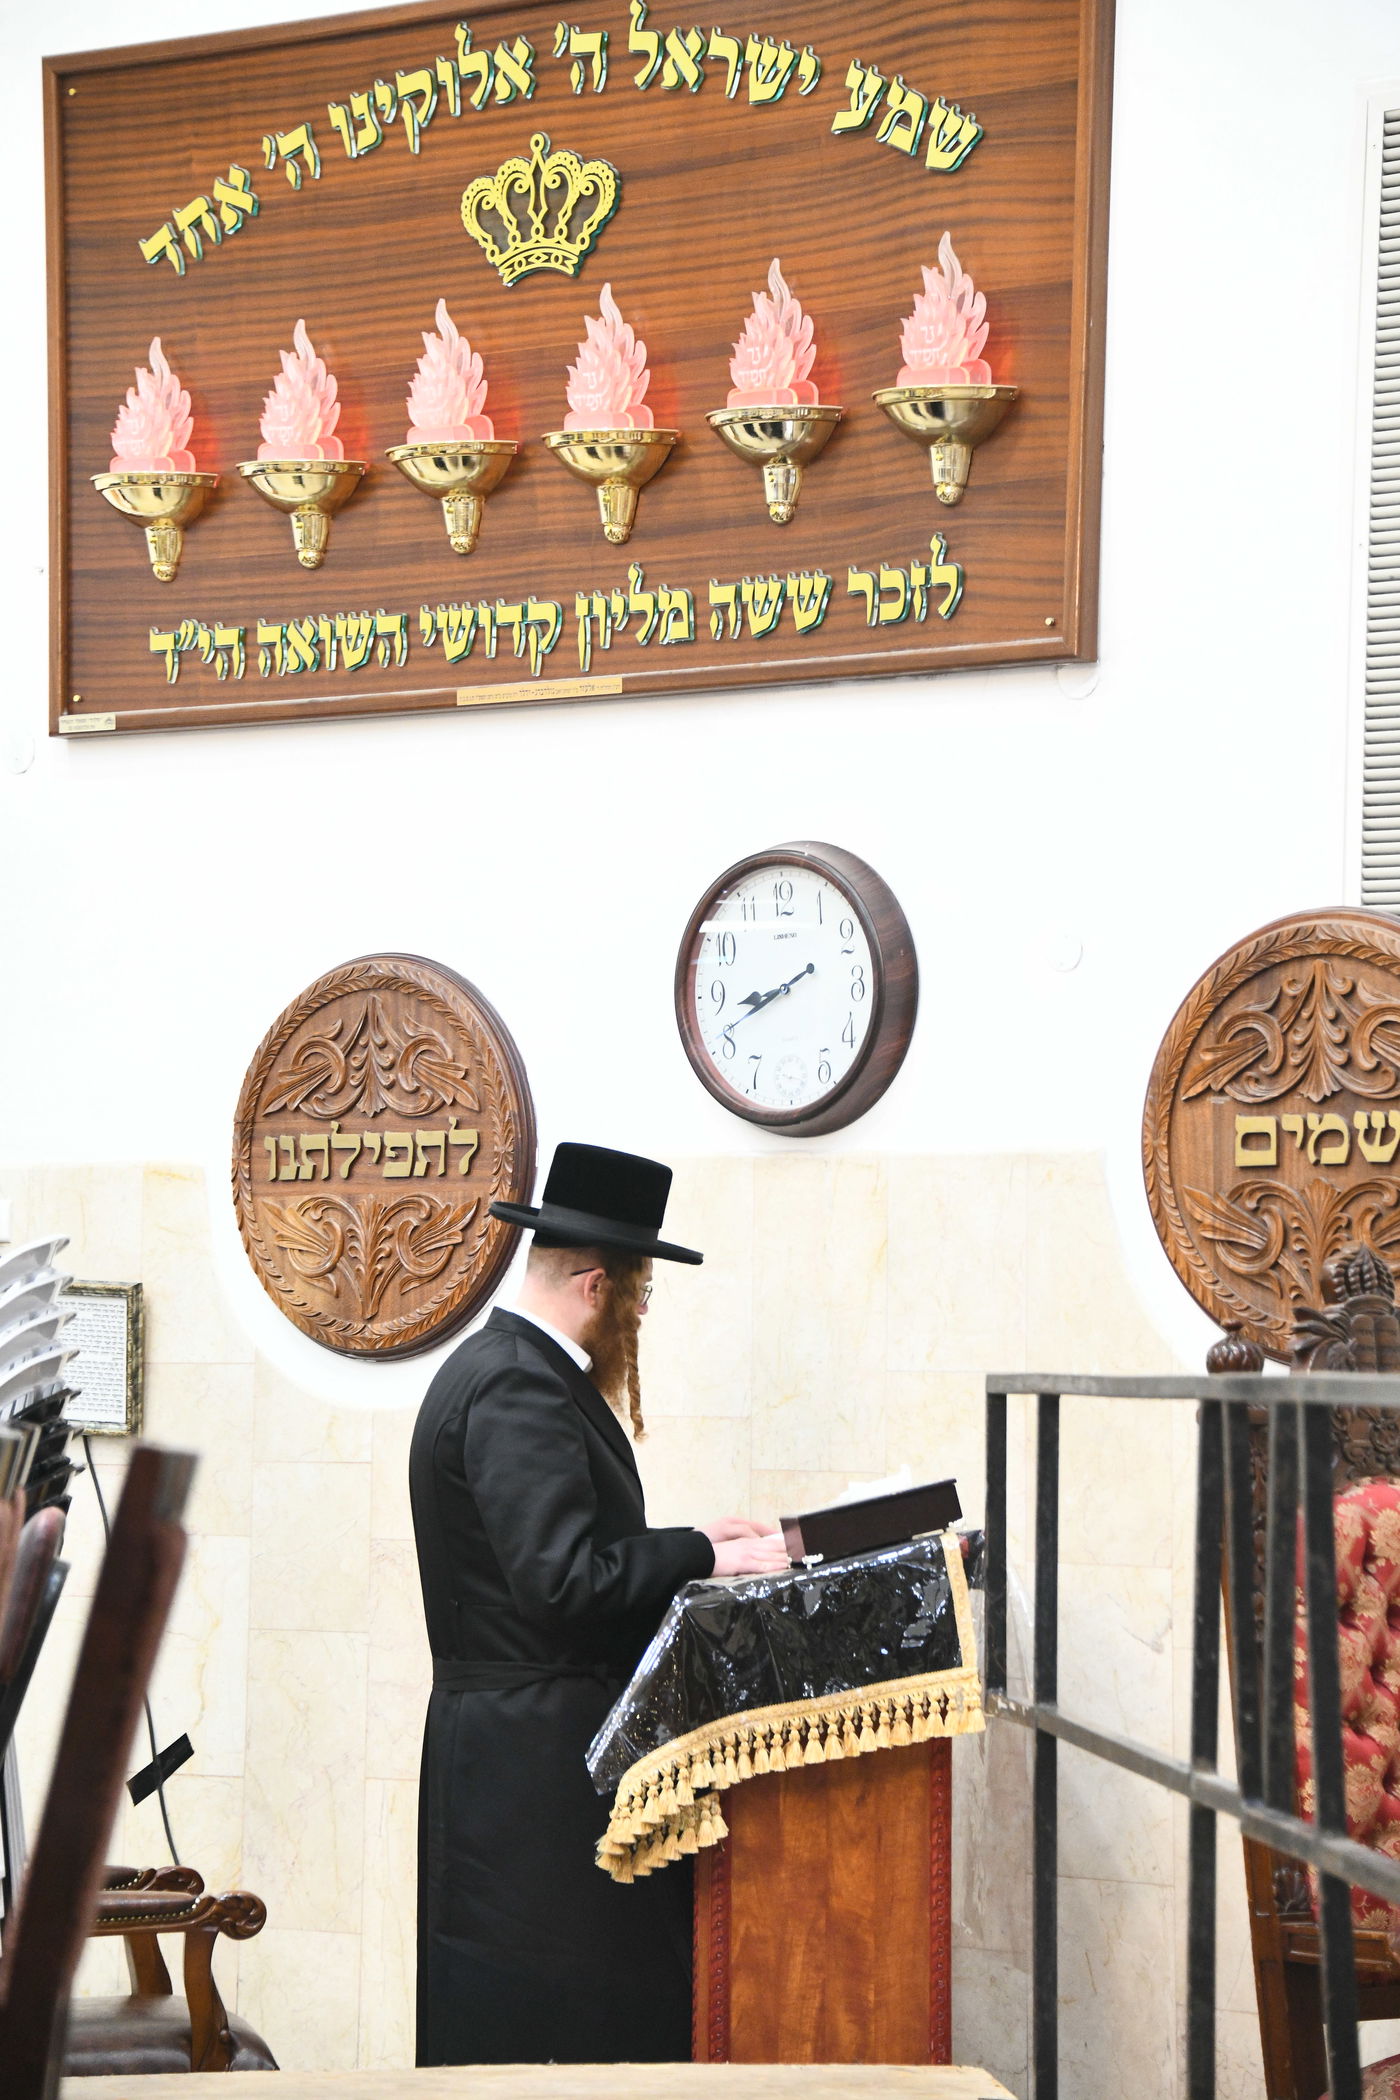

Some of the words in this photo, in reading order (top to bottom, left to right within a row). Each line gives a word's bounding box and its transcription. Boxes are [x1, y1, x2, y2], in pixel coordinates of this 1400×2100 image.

[629, 0, 822, 105] ישראל
[328, 21, 536, 157] אלוקינו
[831, 57, 983, 172] שמע
[138, 163, 259, 275] אחד
[847, 532, 963, 628] לזכר
[575, 561, 695, 672] מליון
[708, 569, 832, 640] ששה
[256, 608, 408, 678] השואה
[419, 596, 563, 677] קדושי
[742, 895, 756, 932] 11
[772, 880, 795, 918] 12
[816, 889, 823, 926] 1
[715, 931, 737, 967] 10
[839, 918, 855, 955] 2
[711, 979, 726, 1016] 9
[851, 964, 865, 1002] 3
[722, 1022, 736, 1060] 8
[841, 1011, 856, 1049] 4
[748, 1054, 762, 1090] 7
[818, 1047, 831, 1084] 5
[264, 1116, 479, 1182] לתפילתנו
[1235, 1109, 1400, 1168] שמים
